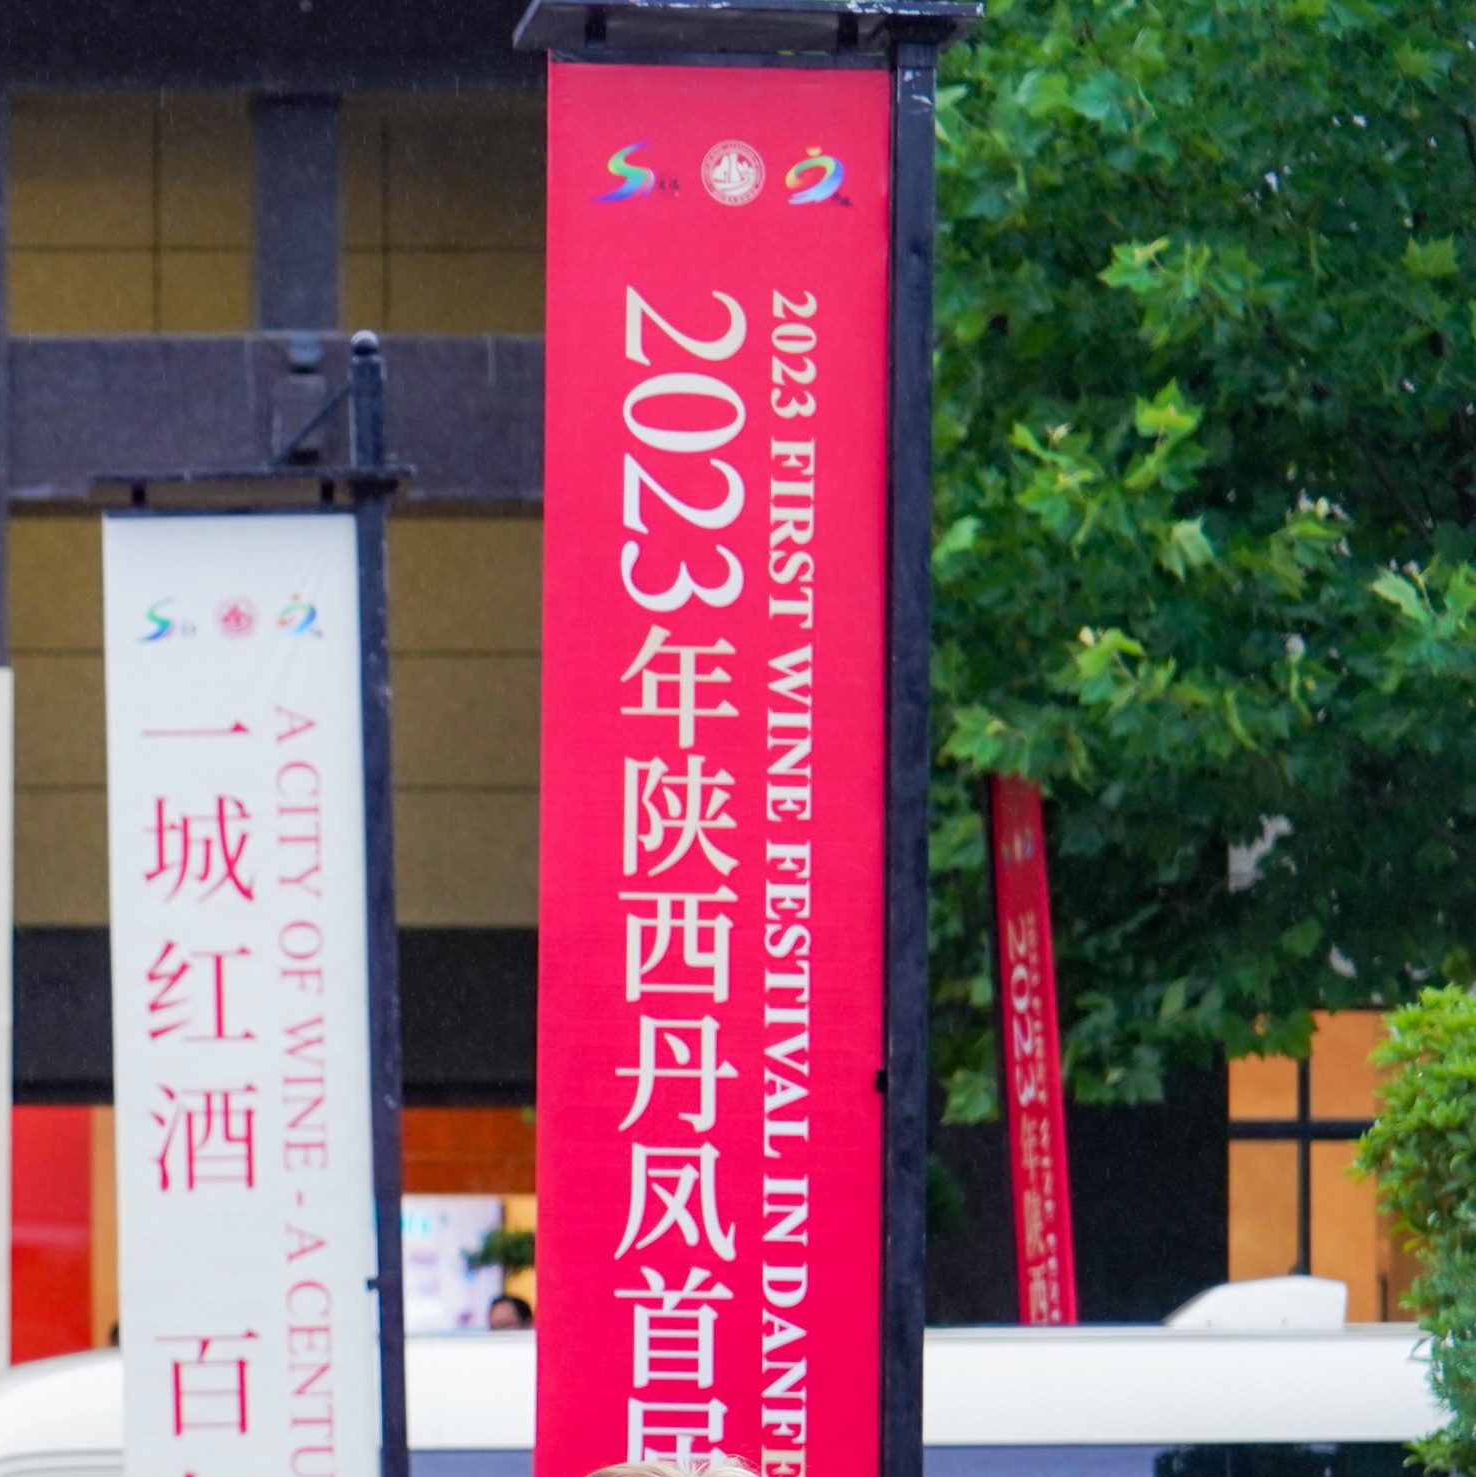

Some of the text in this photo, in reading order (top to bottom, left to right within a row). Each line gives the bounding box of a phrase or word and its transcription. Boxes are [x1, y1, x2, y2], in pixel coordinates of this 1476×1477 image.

[770, 290, 817, 419] 2023
[768, 439, 815, 629] FIRST
[275, 705, 318, 744] A
[766, 645, 813, 821] WINE
[277, 759, 323, 898] CITY
[142, 719, 257, 1193] 一城红酒
[279, 918, 325, 995] OF
[763, 841, 811, 1158] FESTIVAL
[282, 1014, 328, 1172] WINE
[285, 1224, 328, 1263] A
[763, 1177, 808, 1245] IN
